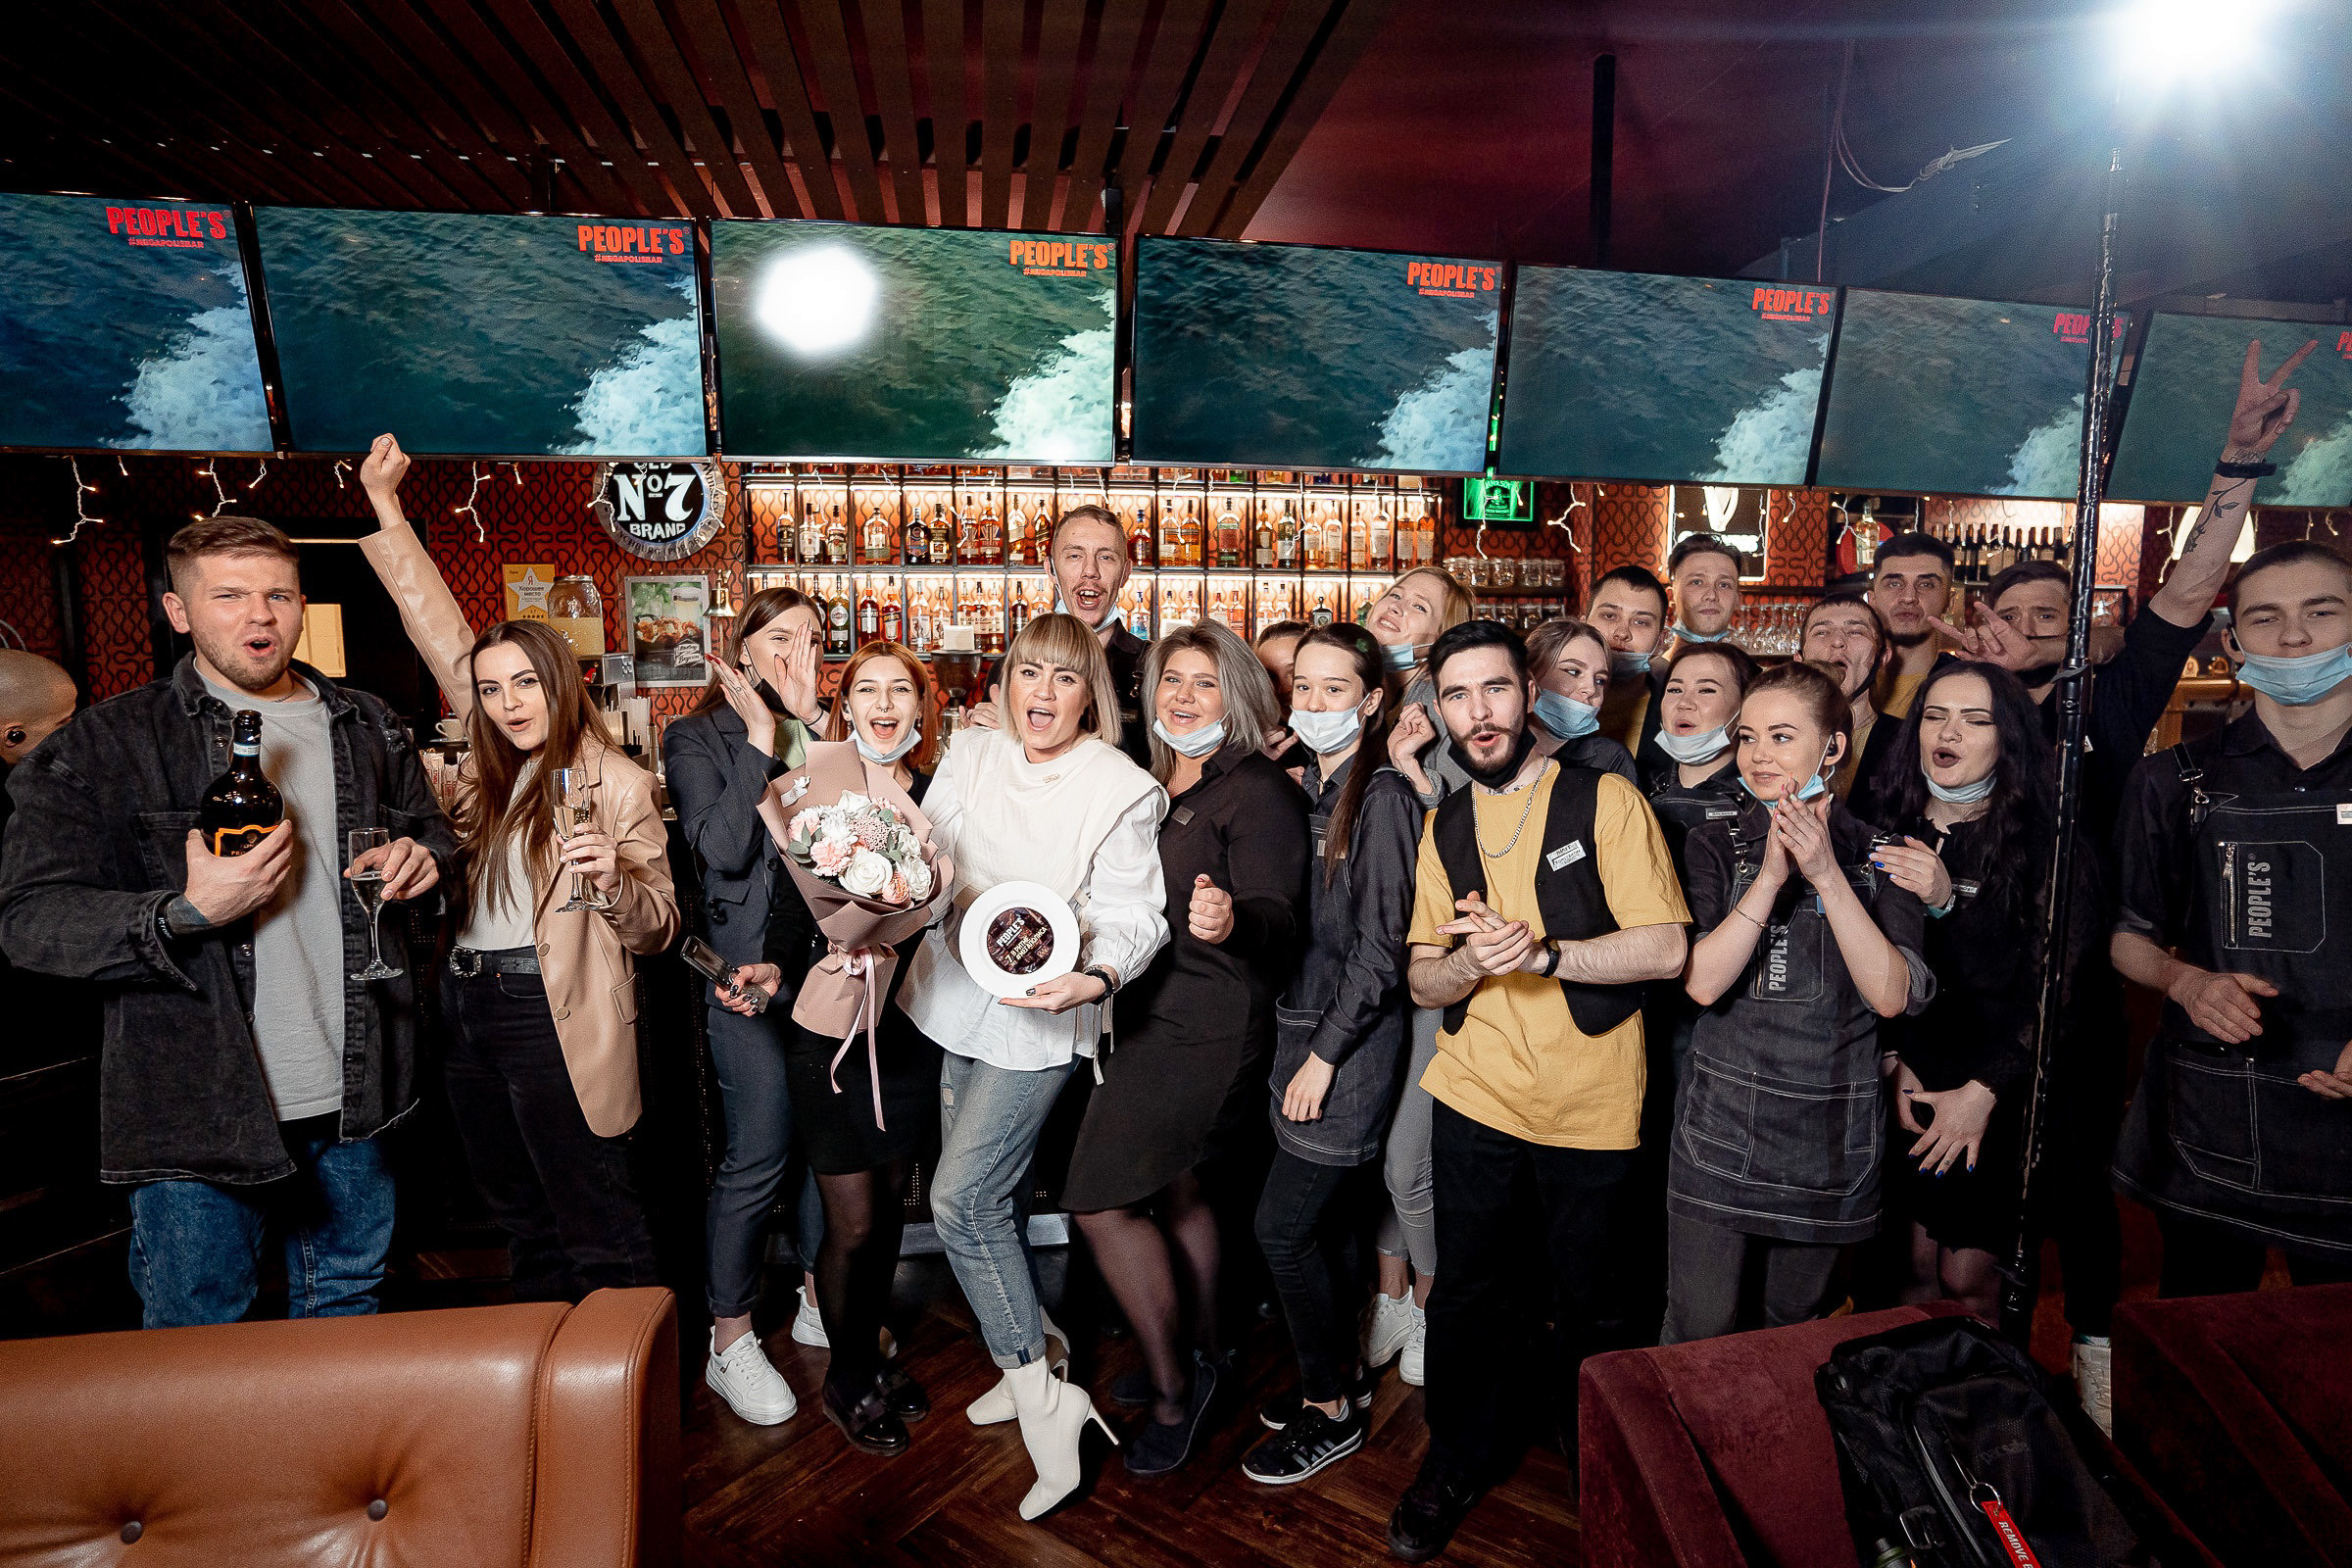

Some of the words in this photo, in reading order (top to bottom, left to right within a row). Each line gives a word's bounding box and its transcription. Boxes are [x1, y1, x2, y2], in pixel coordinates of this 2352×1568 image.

[106, 207, 226, 239] PEOPLE'S
[577, 225, 685, 255] PEOPLE'S
[1009, 240, 1108, 270] PEOPLE'S
[1406, 262, 1495, 291] PEOPLE'S
[1751, 287, 1830, 316] PEOPLE'S
[629, 522, 686, 541] BRAND
[2247, 861, 2273, 939] PEOPLE'S
[996, 917, 1026, 948] PEOPLE'S
[1998, 1521, 2030, 1562] REMOVE
